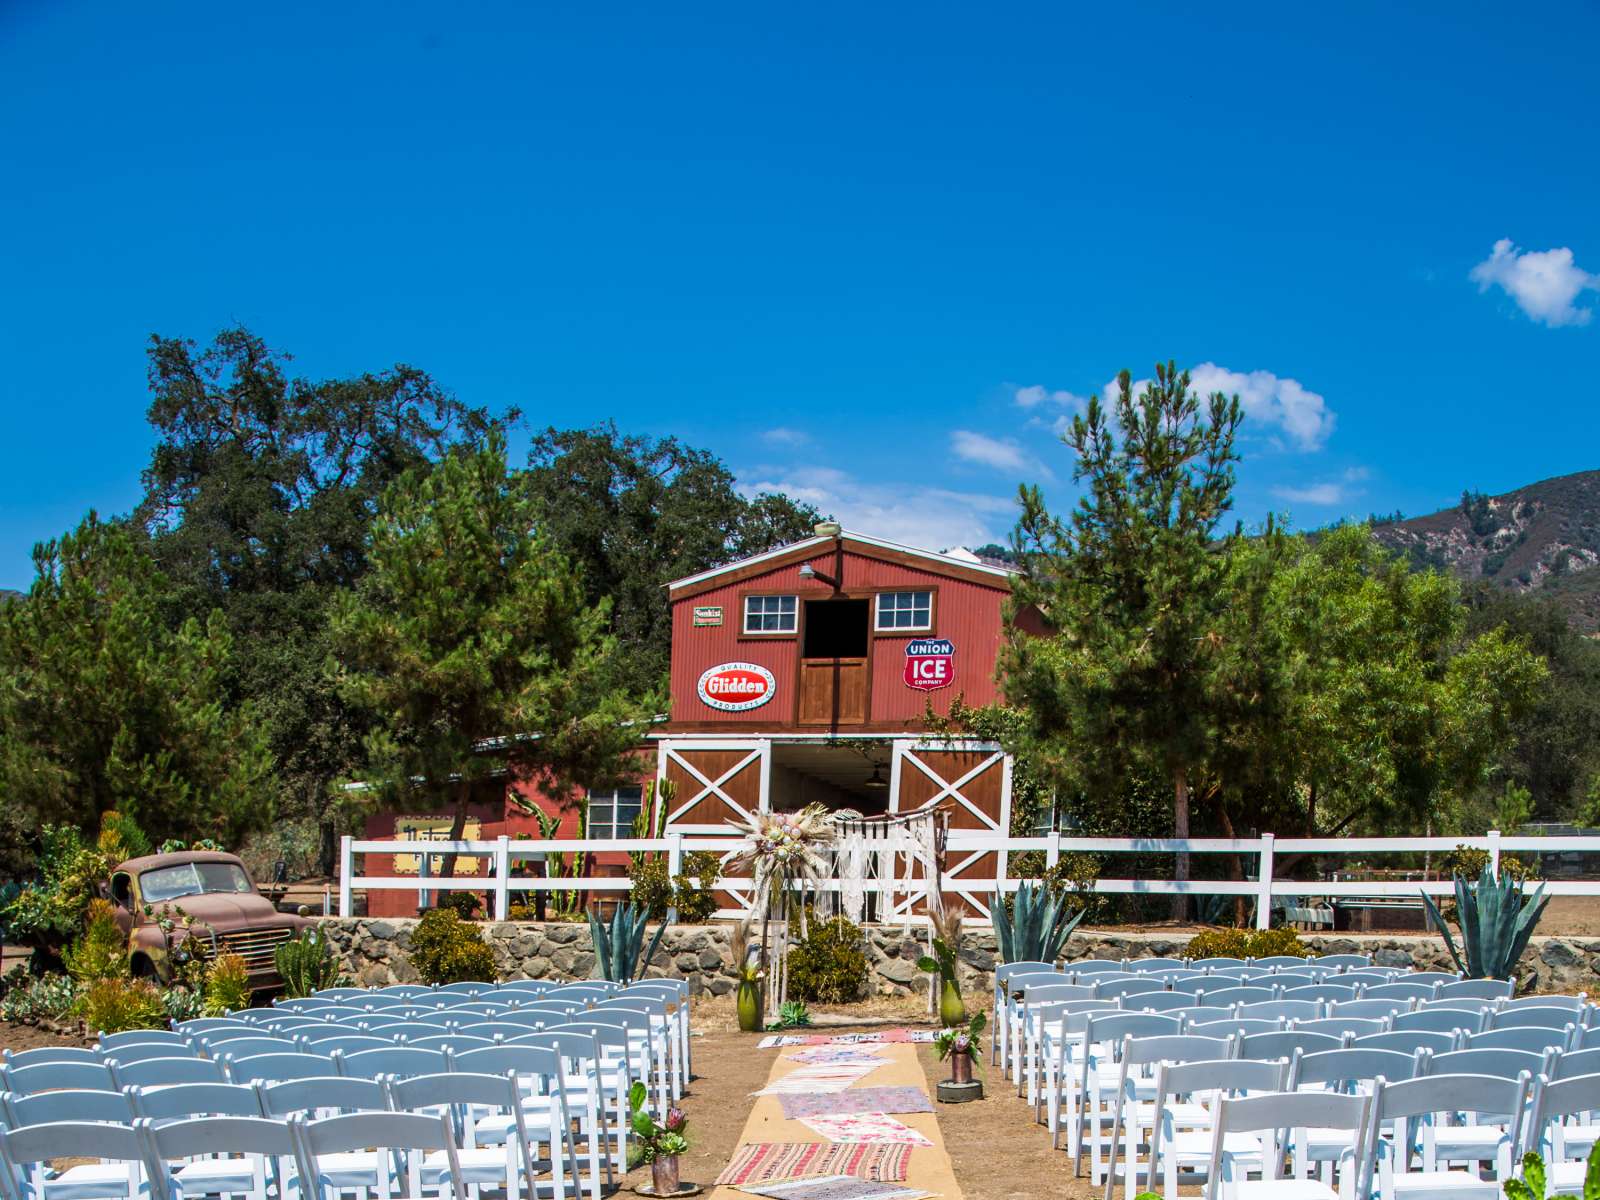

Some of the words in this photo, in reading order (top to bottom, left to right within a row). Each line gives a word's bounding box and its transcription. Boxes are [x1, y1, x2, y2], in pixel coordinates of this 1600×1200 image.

[910, 644, 950, 654] UNION
[720, 664, 758, 672] QUALITY
[912, 659, 946, 679] ICE
[708, 676, 765, 694] Glidden
[713, 701, 759, 710] PRODUCTS
